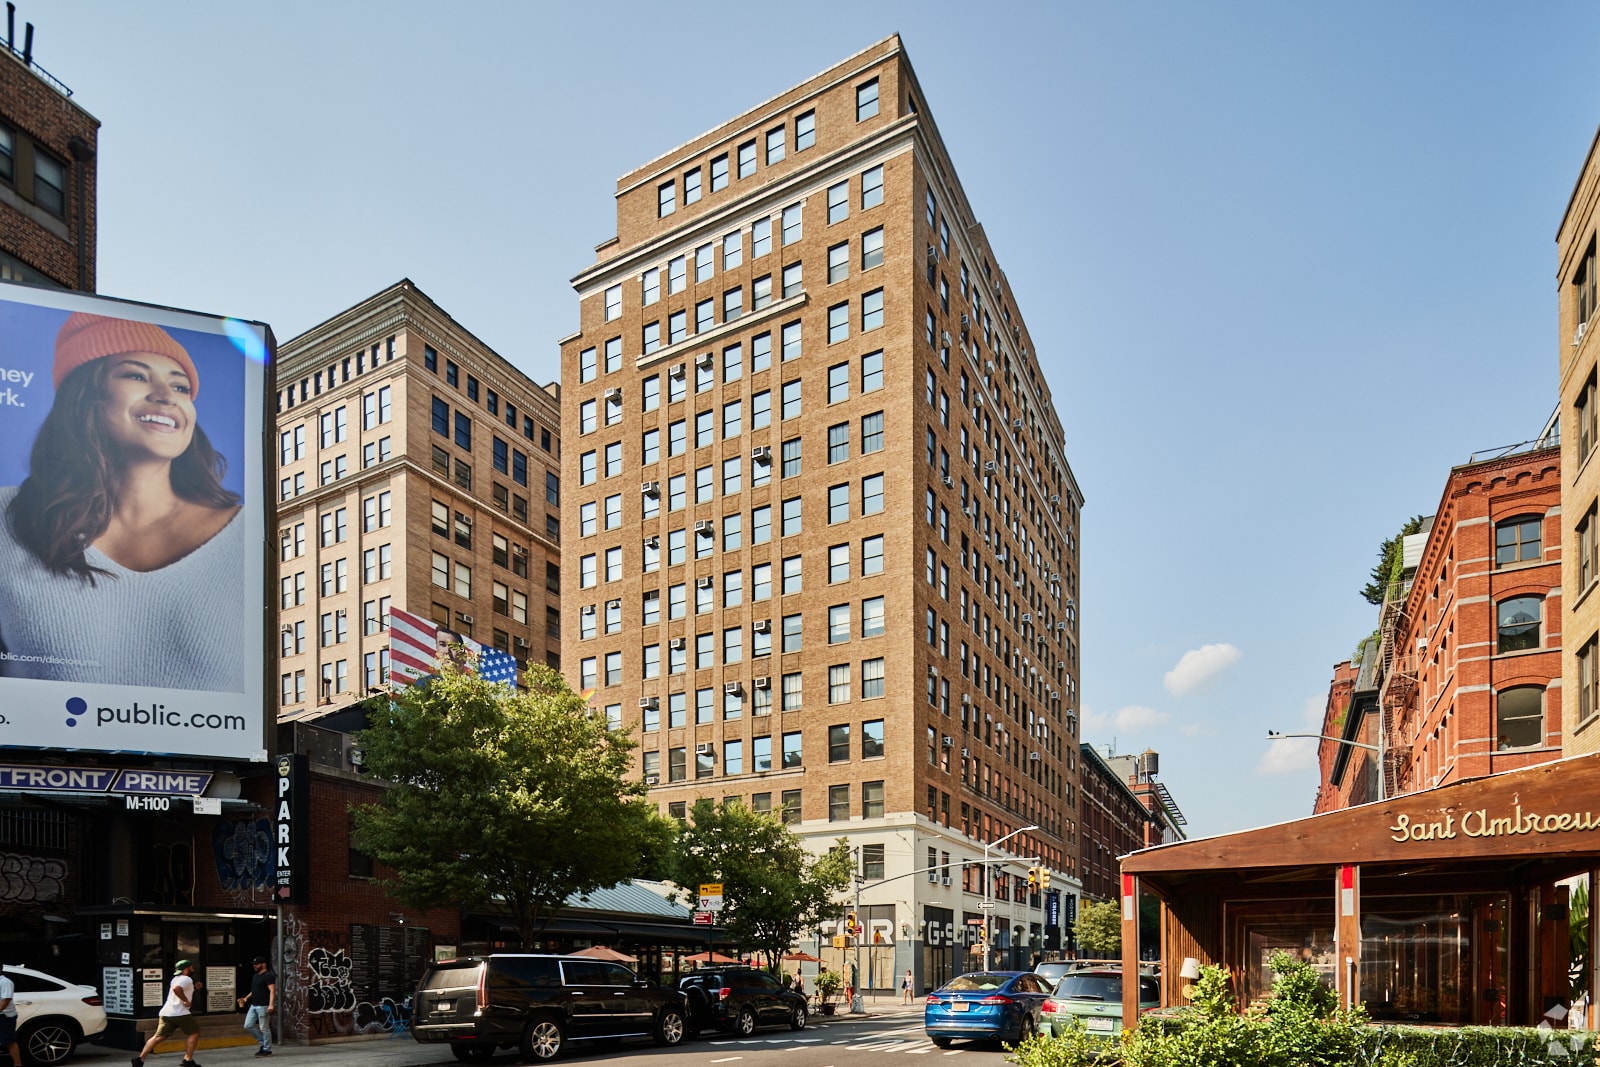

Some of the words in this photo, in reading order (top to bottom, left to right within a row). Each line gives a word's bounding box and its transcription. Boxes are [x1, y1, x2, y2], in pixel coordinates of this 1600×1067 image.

[97, 702, 245, 730] public.com
[125, 774, 201, 791] PRIME
[126, 796, 170, 811] M-1100
[277, 777, 291, 867] PARK
[1390, 813, 1456, 842] Sant
[1461, 805, 1600, 837] Ambroeu
